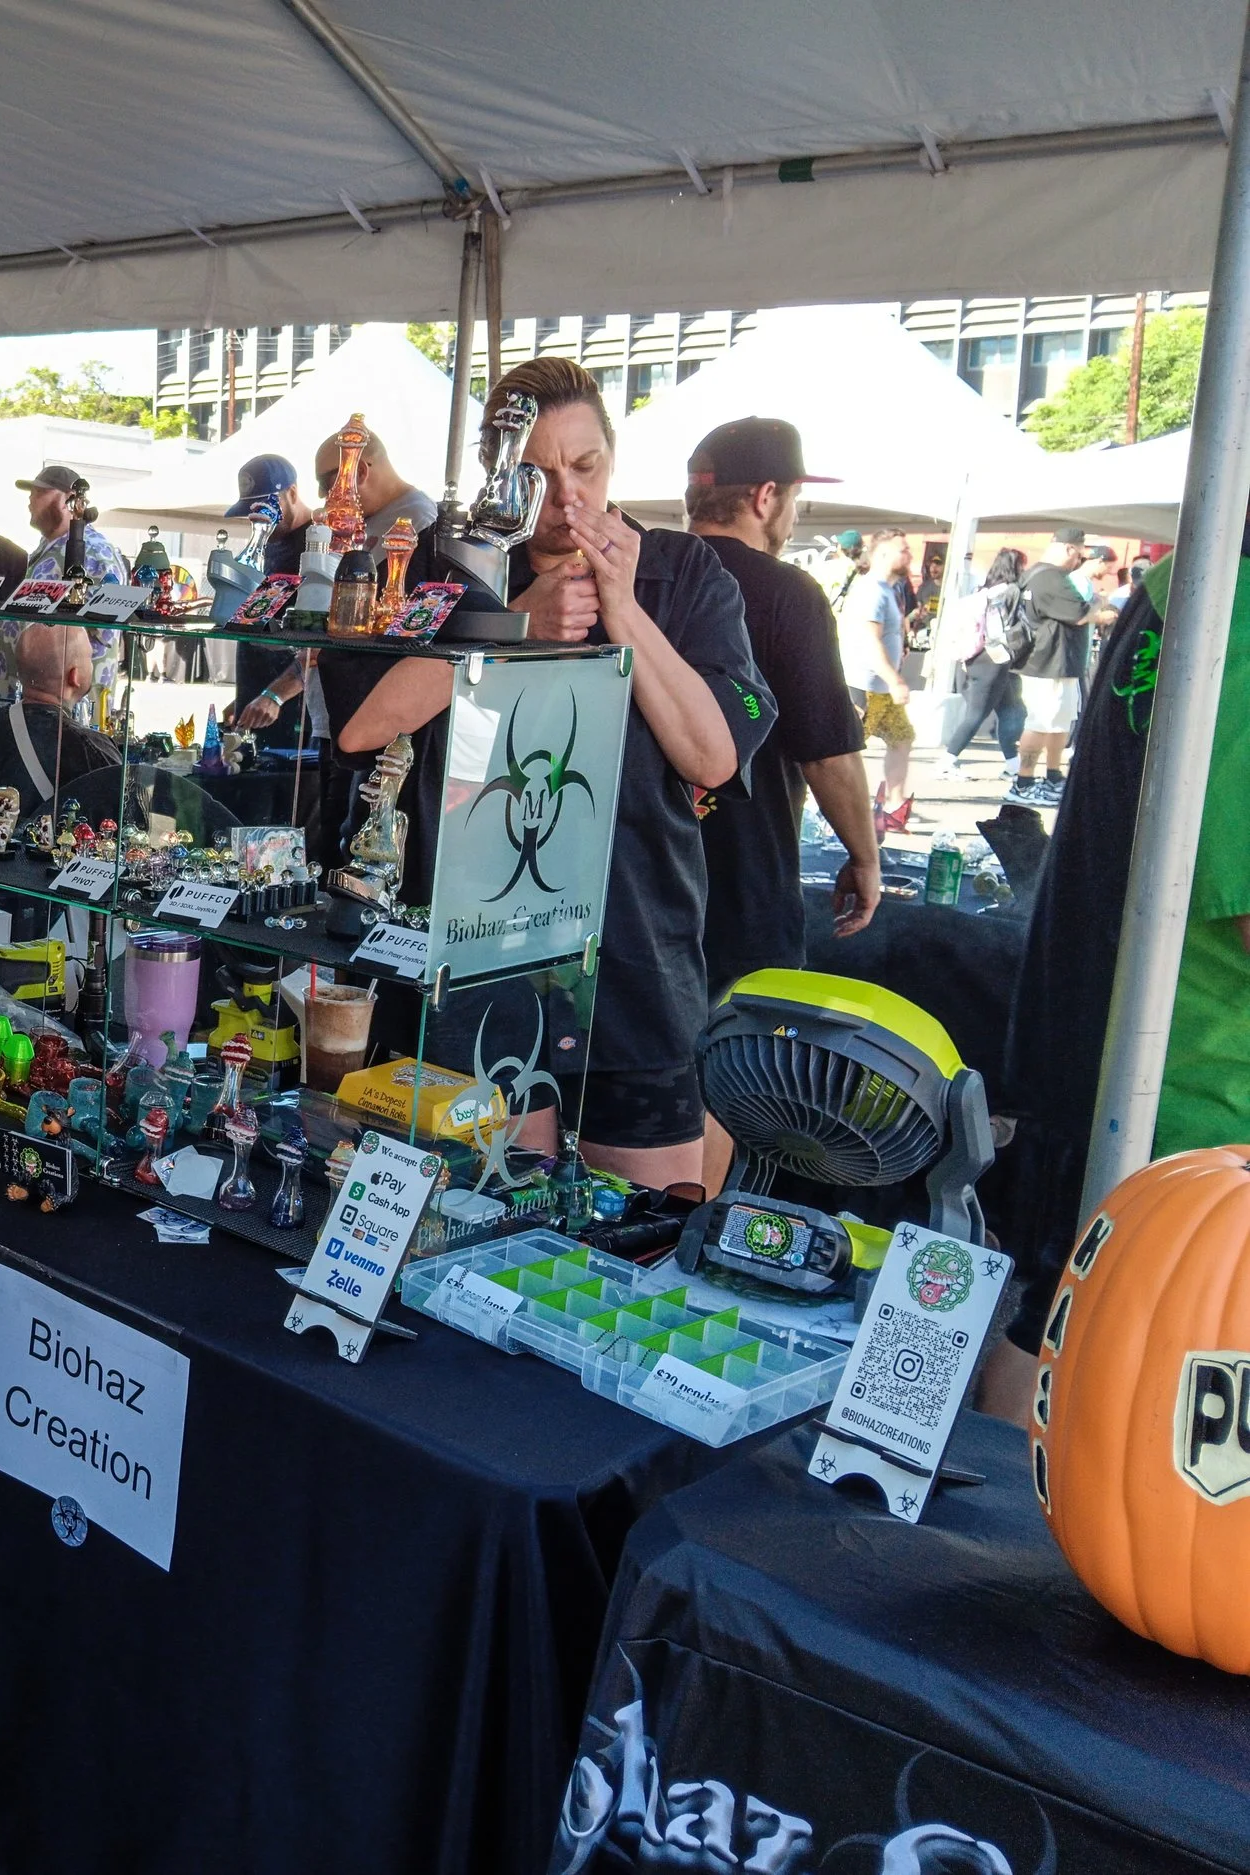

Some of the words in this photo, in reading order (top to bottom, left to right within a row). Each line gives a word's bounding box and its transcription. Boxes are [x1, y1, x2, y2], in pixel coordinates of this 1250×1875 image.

[102, 597, 138, 608] PUFFCO
[743, 694, 761, 719] 1999
[71, 875, 96, 887] PIVOT
[80, 865, 115, 880] PUFFCO
[185, 890, 232, 905] PUFFCO
[445, 912, 506, 945] Biohaz
[512, 899, 592, 932] Creations
[385, 934, 428, 953] PUFFC
[356, 1096, 390, 1116] Cinnamon
[389, 1107, 407, 1122] Rolls
[380, 1090, 407, 1109] Dopest
[381, 1145, 394, 1158] We
[381, 1171, 407, 1196] Pay
[367, 1192, 390, 1211] Cash
[390, 1202, 411, 1219] App
[357, 1214, 400, 1242] Square
[344, 1250, 386, 1277] venmo
[326, 1268, 362, 1298] Zelle
[28, 1316, 146, 1416] Biohaz
[5, 1385, 152, 1501] Creation
[841, 1406, 932, 1456] @BIOHAZCREATIONS
